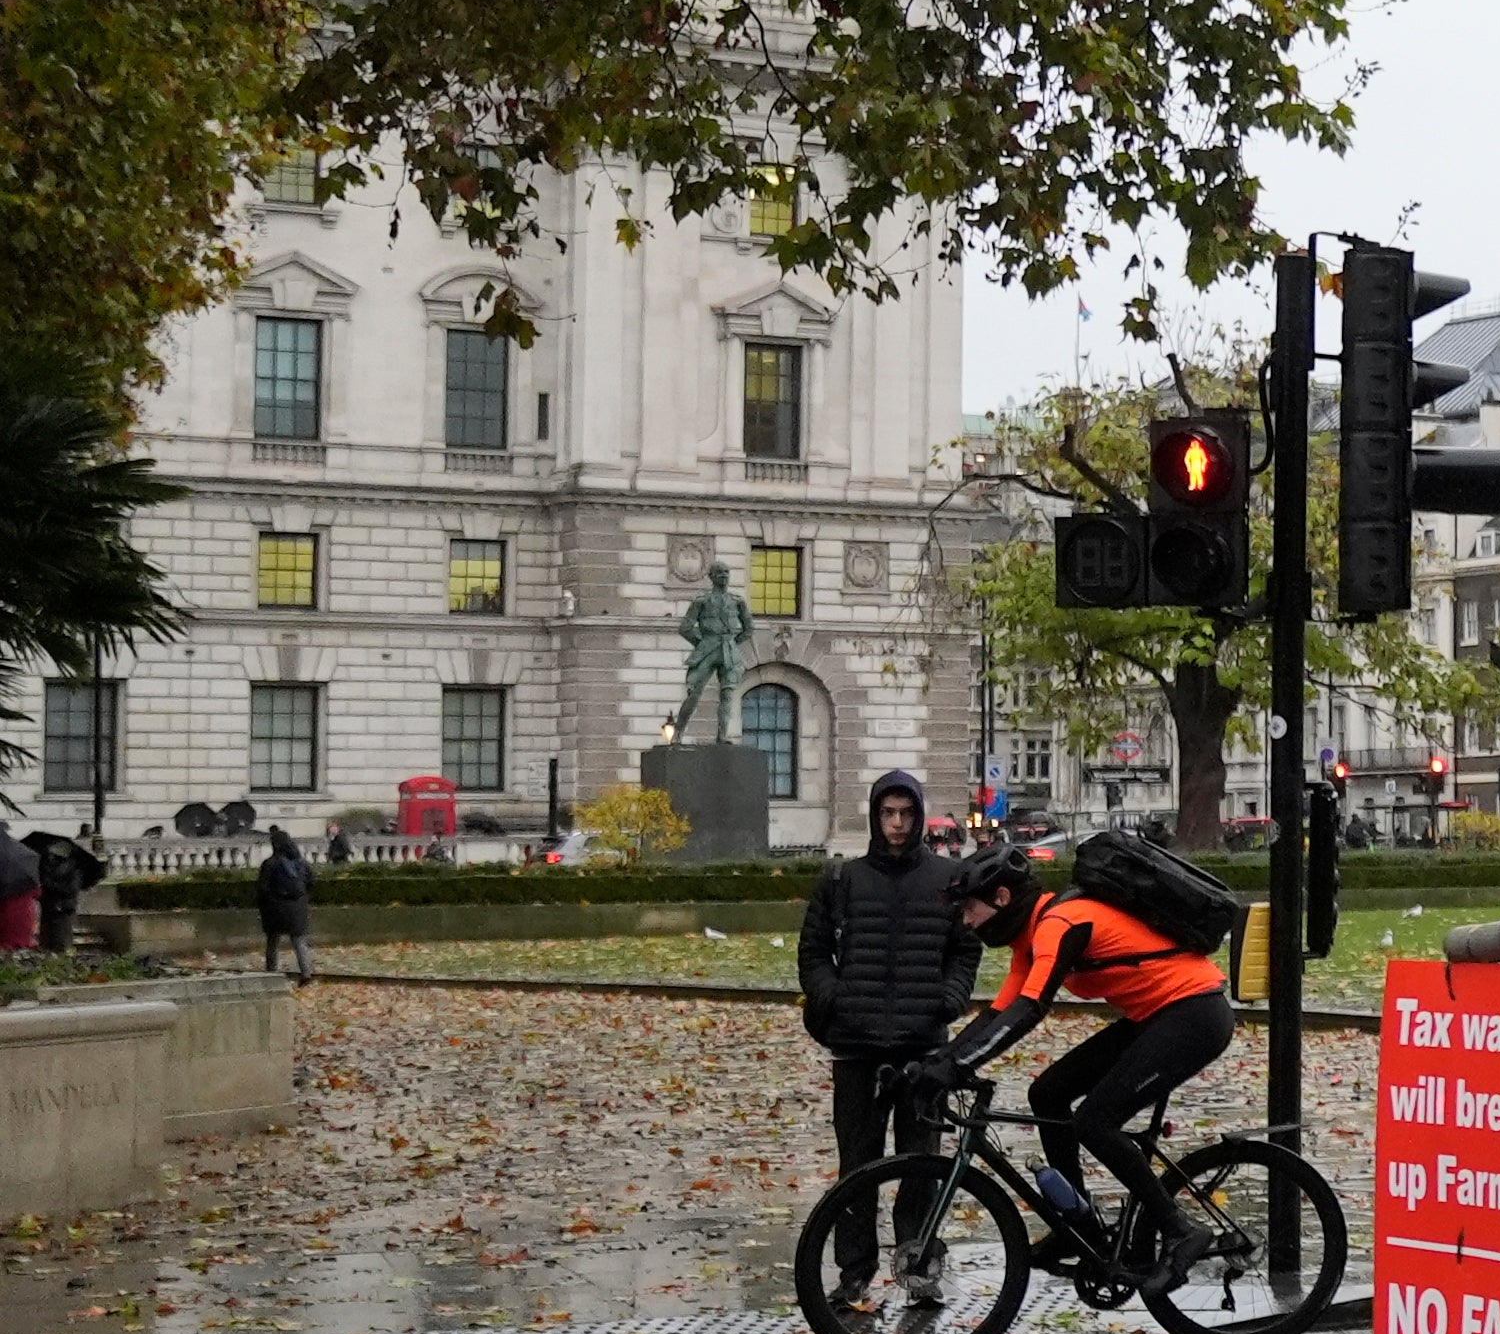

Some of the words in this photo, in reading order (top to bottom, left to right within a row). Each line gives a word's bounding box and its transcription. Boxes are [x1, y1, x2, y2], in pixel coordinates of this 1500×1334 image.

[1396, 997, 1454, 1048] Tax
[1390, 1075, 1445, 1125] will
[1388, 1161, 1426, 1211] up
